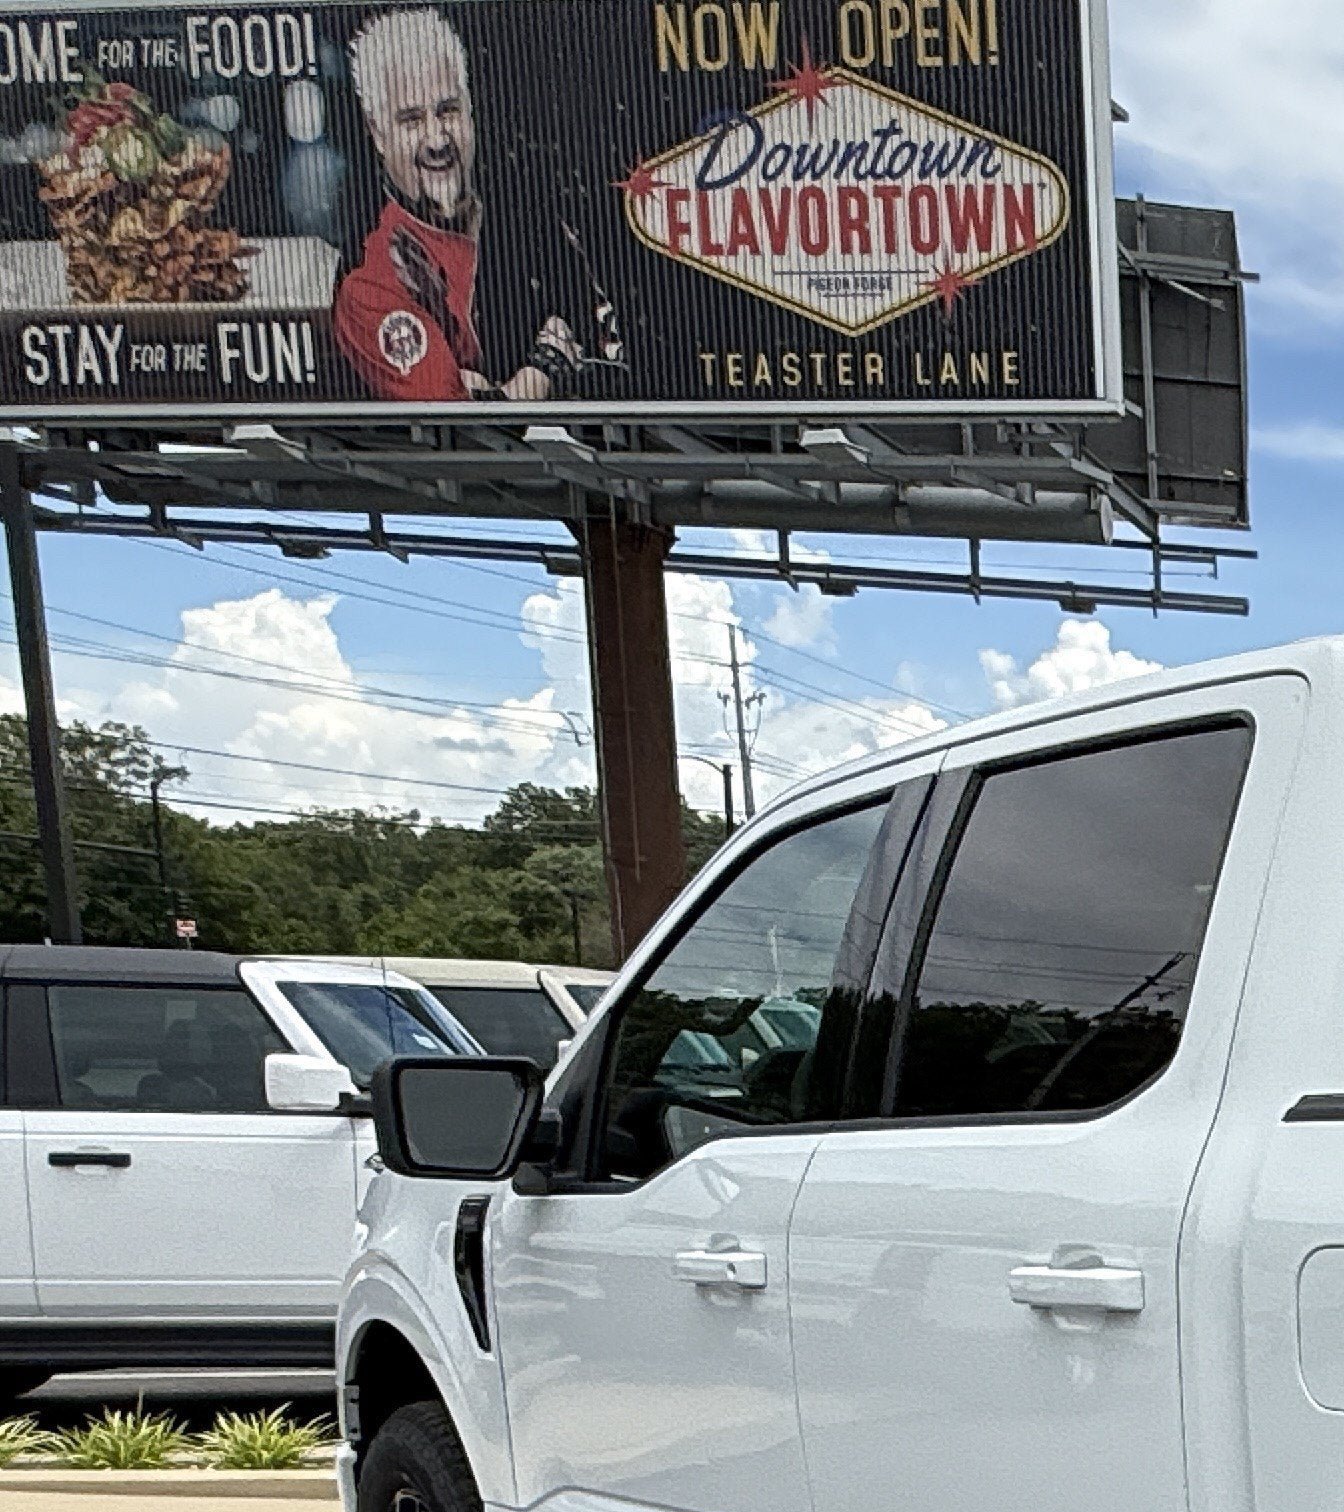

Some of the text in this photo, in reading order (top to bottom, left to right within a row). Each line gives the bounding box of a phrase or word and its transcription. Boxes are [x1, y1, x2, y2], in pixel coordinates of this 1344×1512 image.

[98, 38, 134, 68] FOR
[140, 38, 178, 68] THE
[186, 12, 317, 79] FOOD!
[656, 0, 999, 72] NOW OPEN!
[697, 108, 1002, 191] Downtown
[665, 183, 1038, 257] FLAVORTOWN
[22, 321, 316, 386] STAY FOR THE FUN!
[700, 350, 1019, 386] TEASTER LANE
